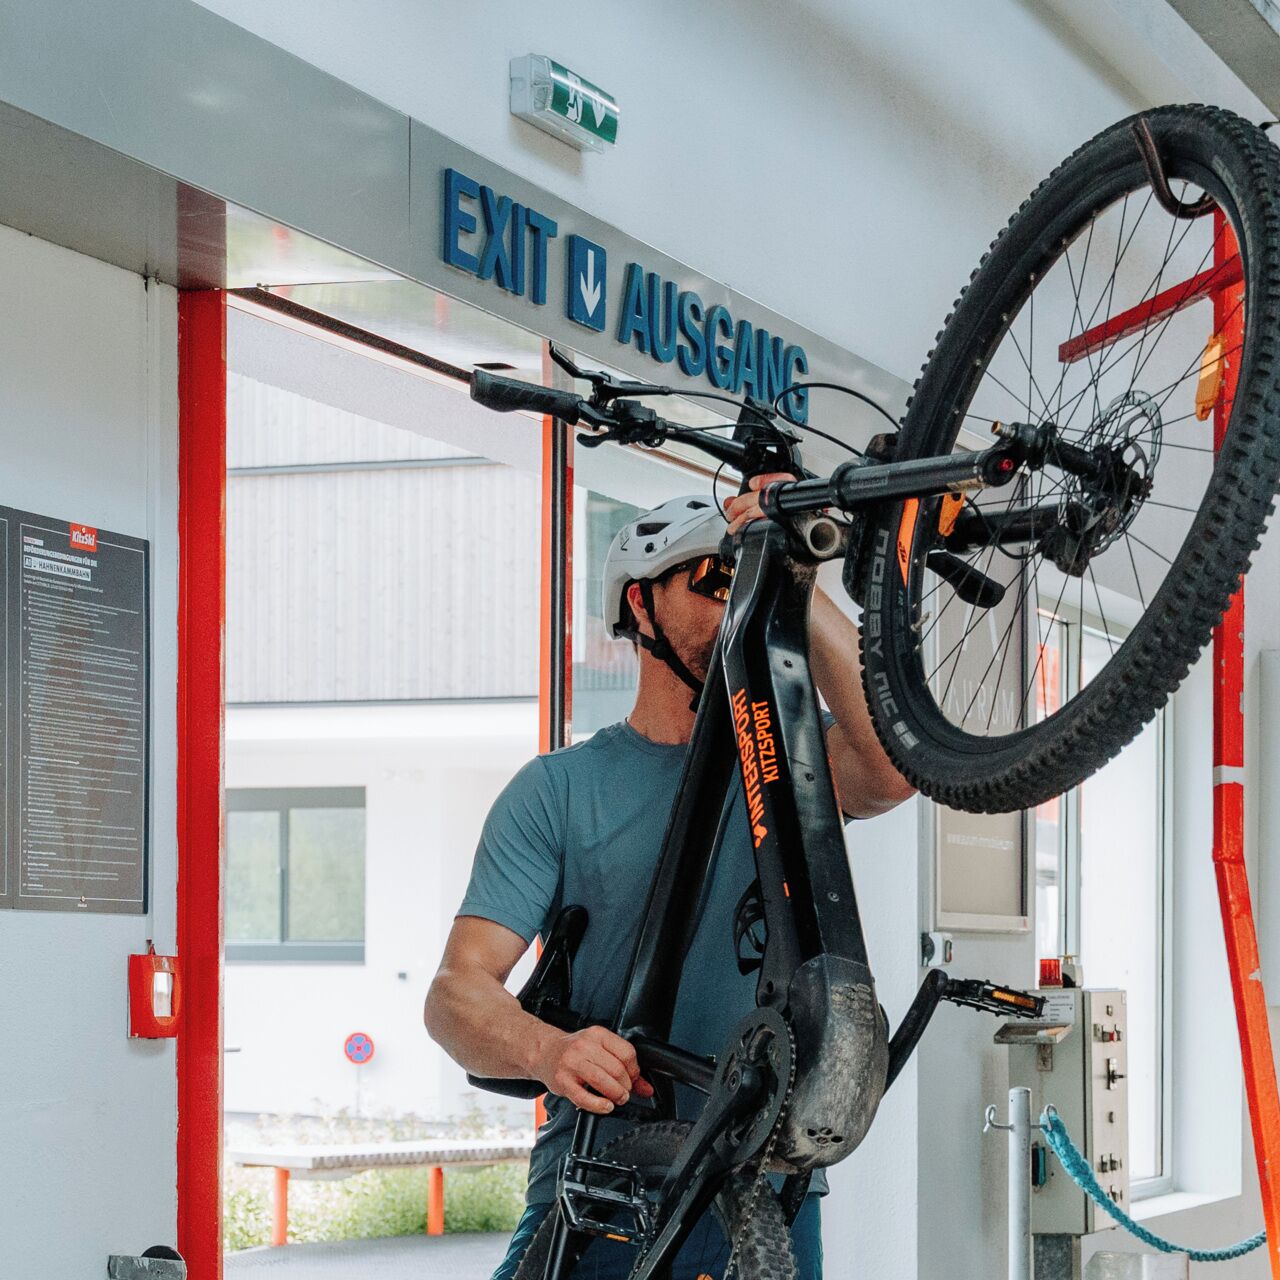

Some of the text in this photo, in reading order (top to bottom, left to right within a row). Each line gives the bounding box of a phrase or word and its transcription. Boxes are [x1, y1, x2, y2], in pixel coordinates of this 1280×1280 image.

[443, 168, 809, 426] EXIT AUSGANG
[731, 687, 766, 828] INTERSPORT
[752, 700, 780, 784] KITZSPORT
